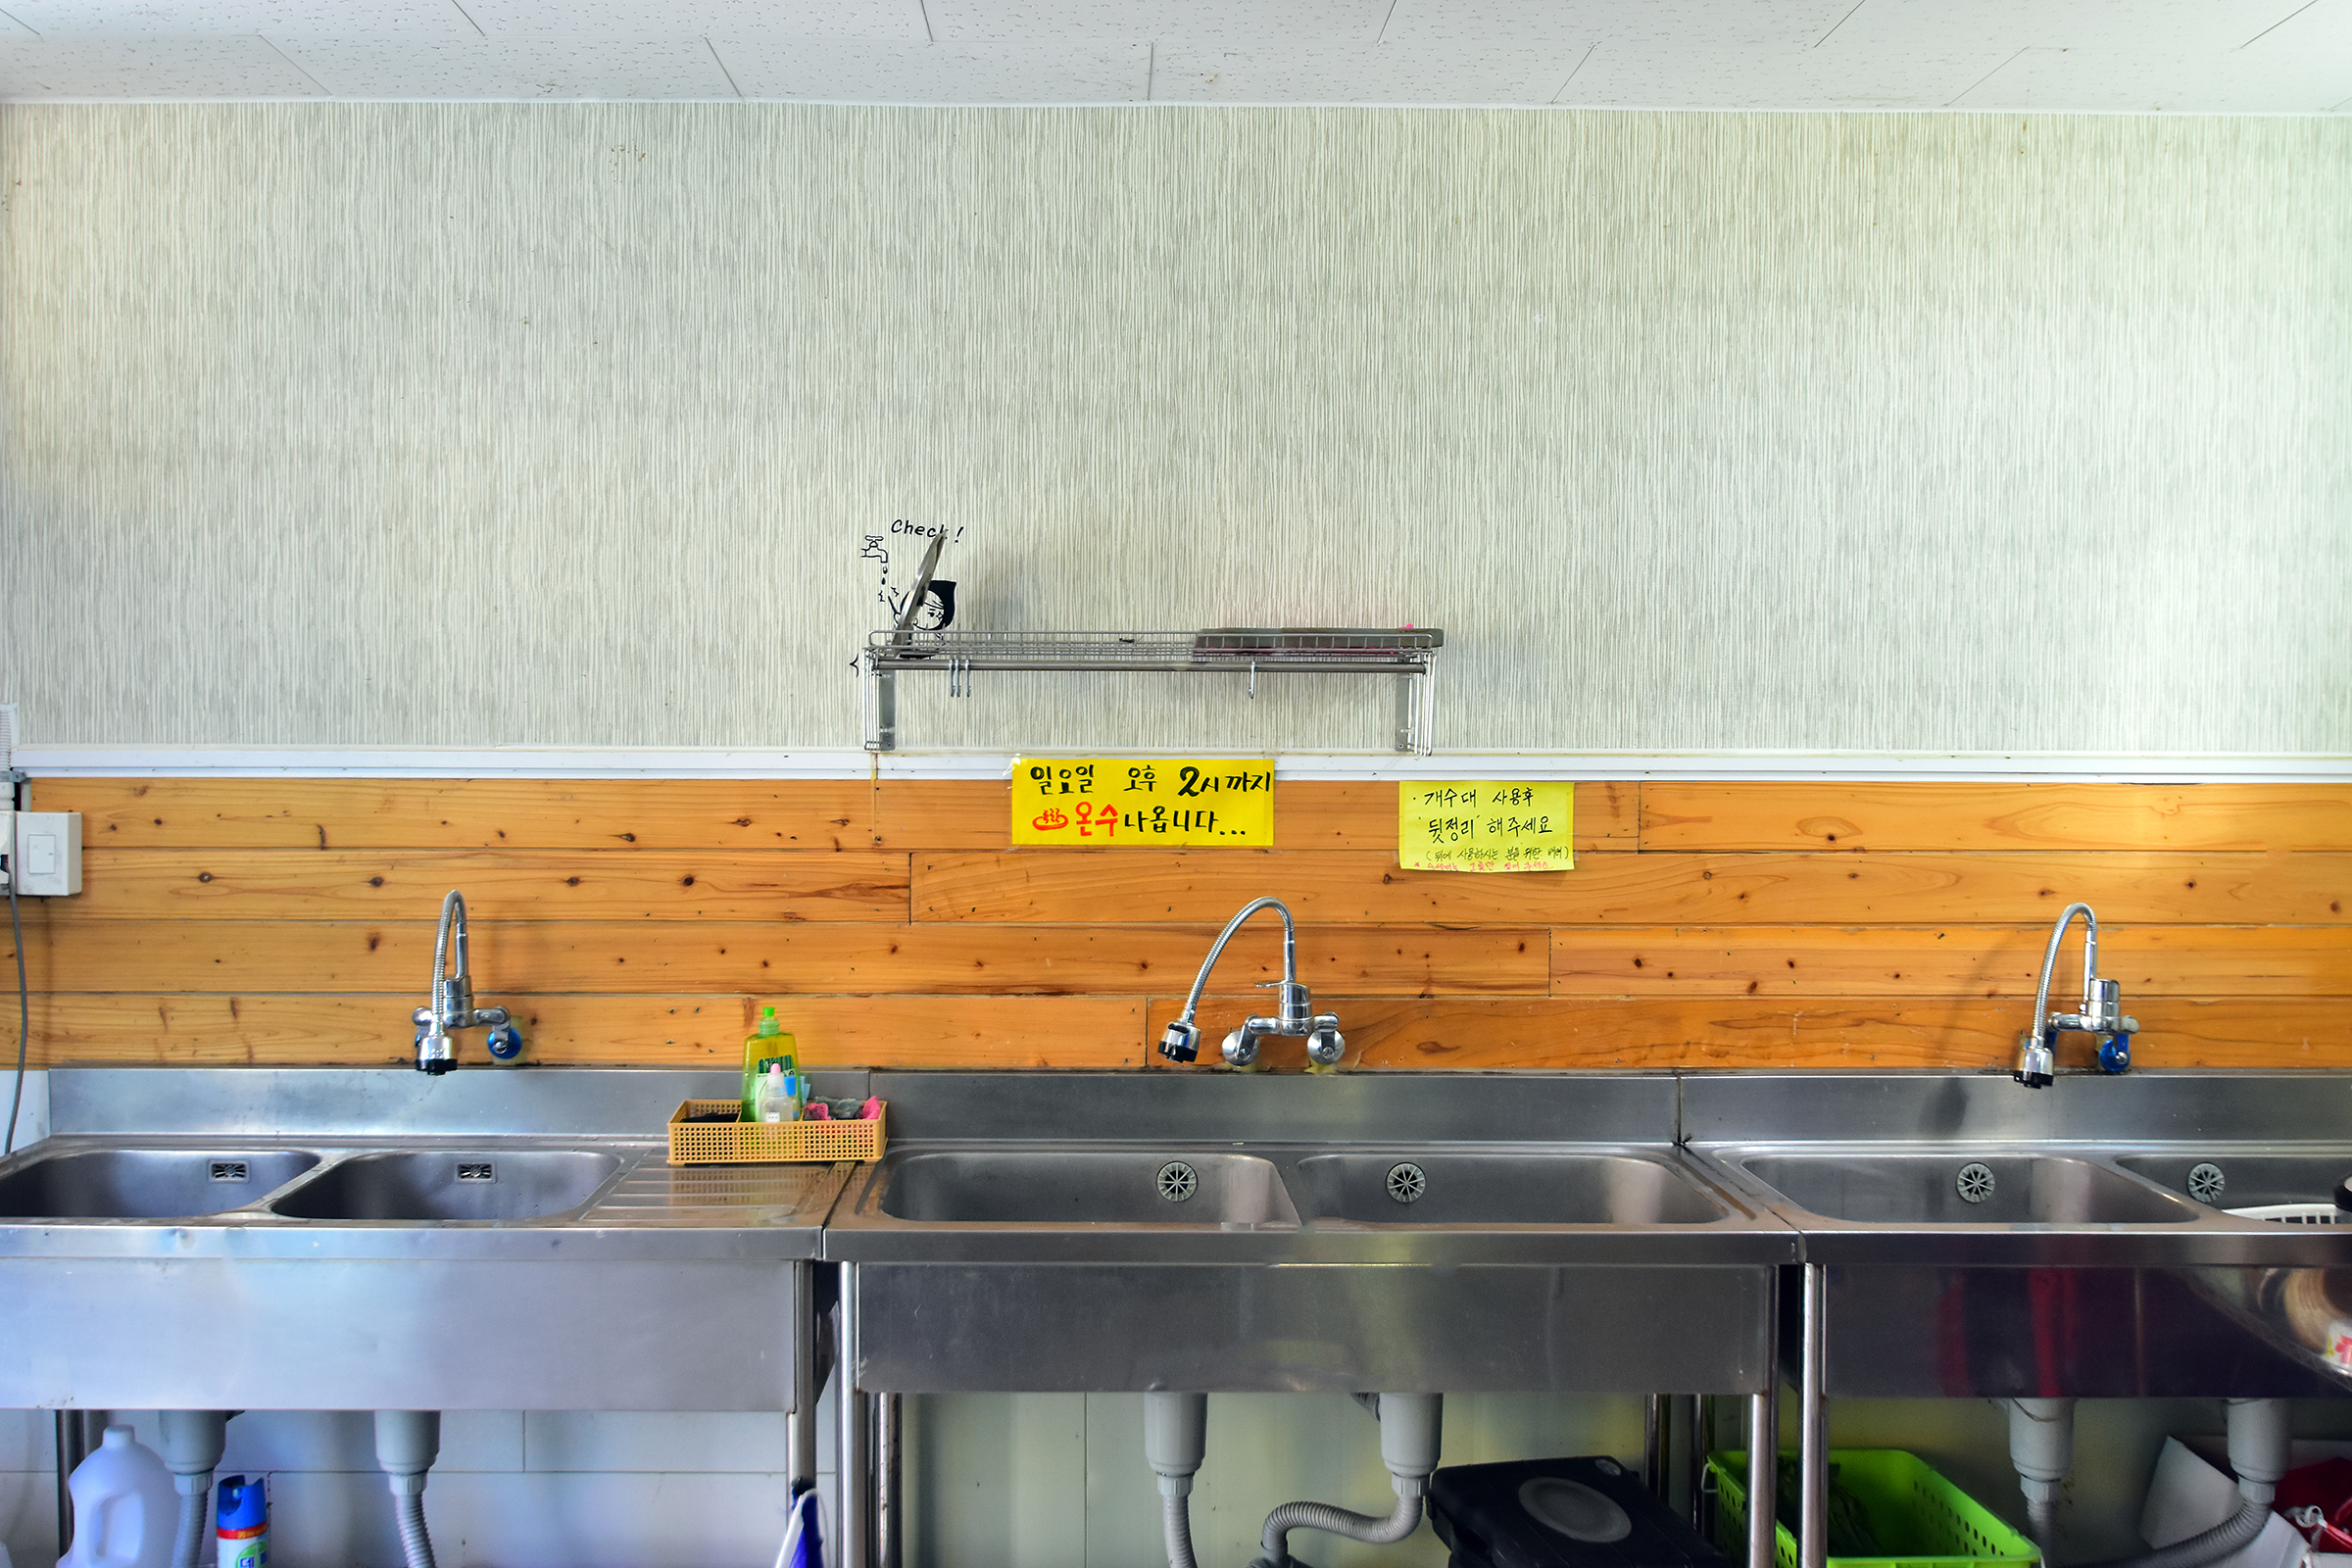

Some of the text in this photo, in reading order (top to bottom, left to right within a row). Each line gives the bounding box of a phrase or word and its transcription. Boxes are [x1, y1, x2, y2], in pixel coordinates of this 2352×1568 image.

[1030, 763, 1095, 795] 일요일
[1123, 764, 1157, 792] 오후
[1424, 787, 1534, 808] 개수대 사용후
[1075, 801, 1118, 837] 온수
[1523, 846, 1543, 860] 위한
